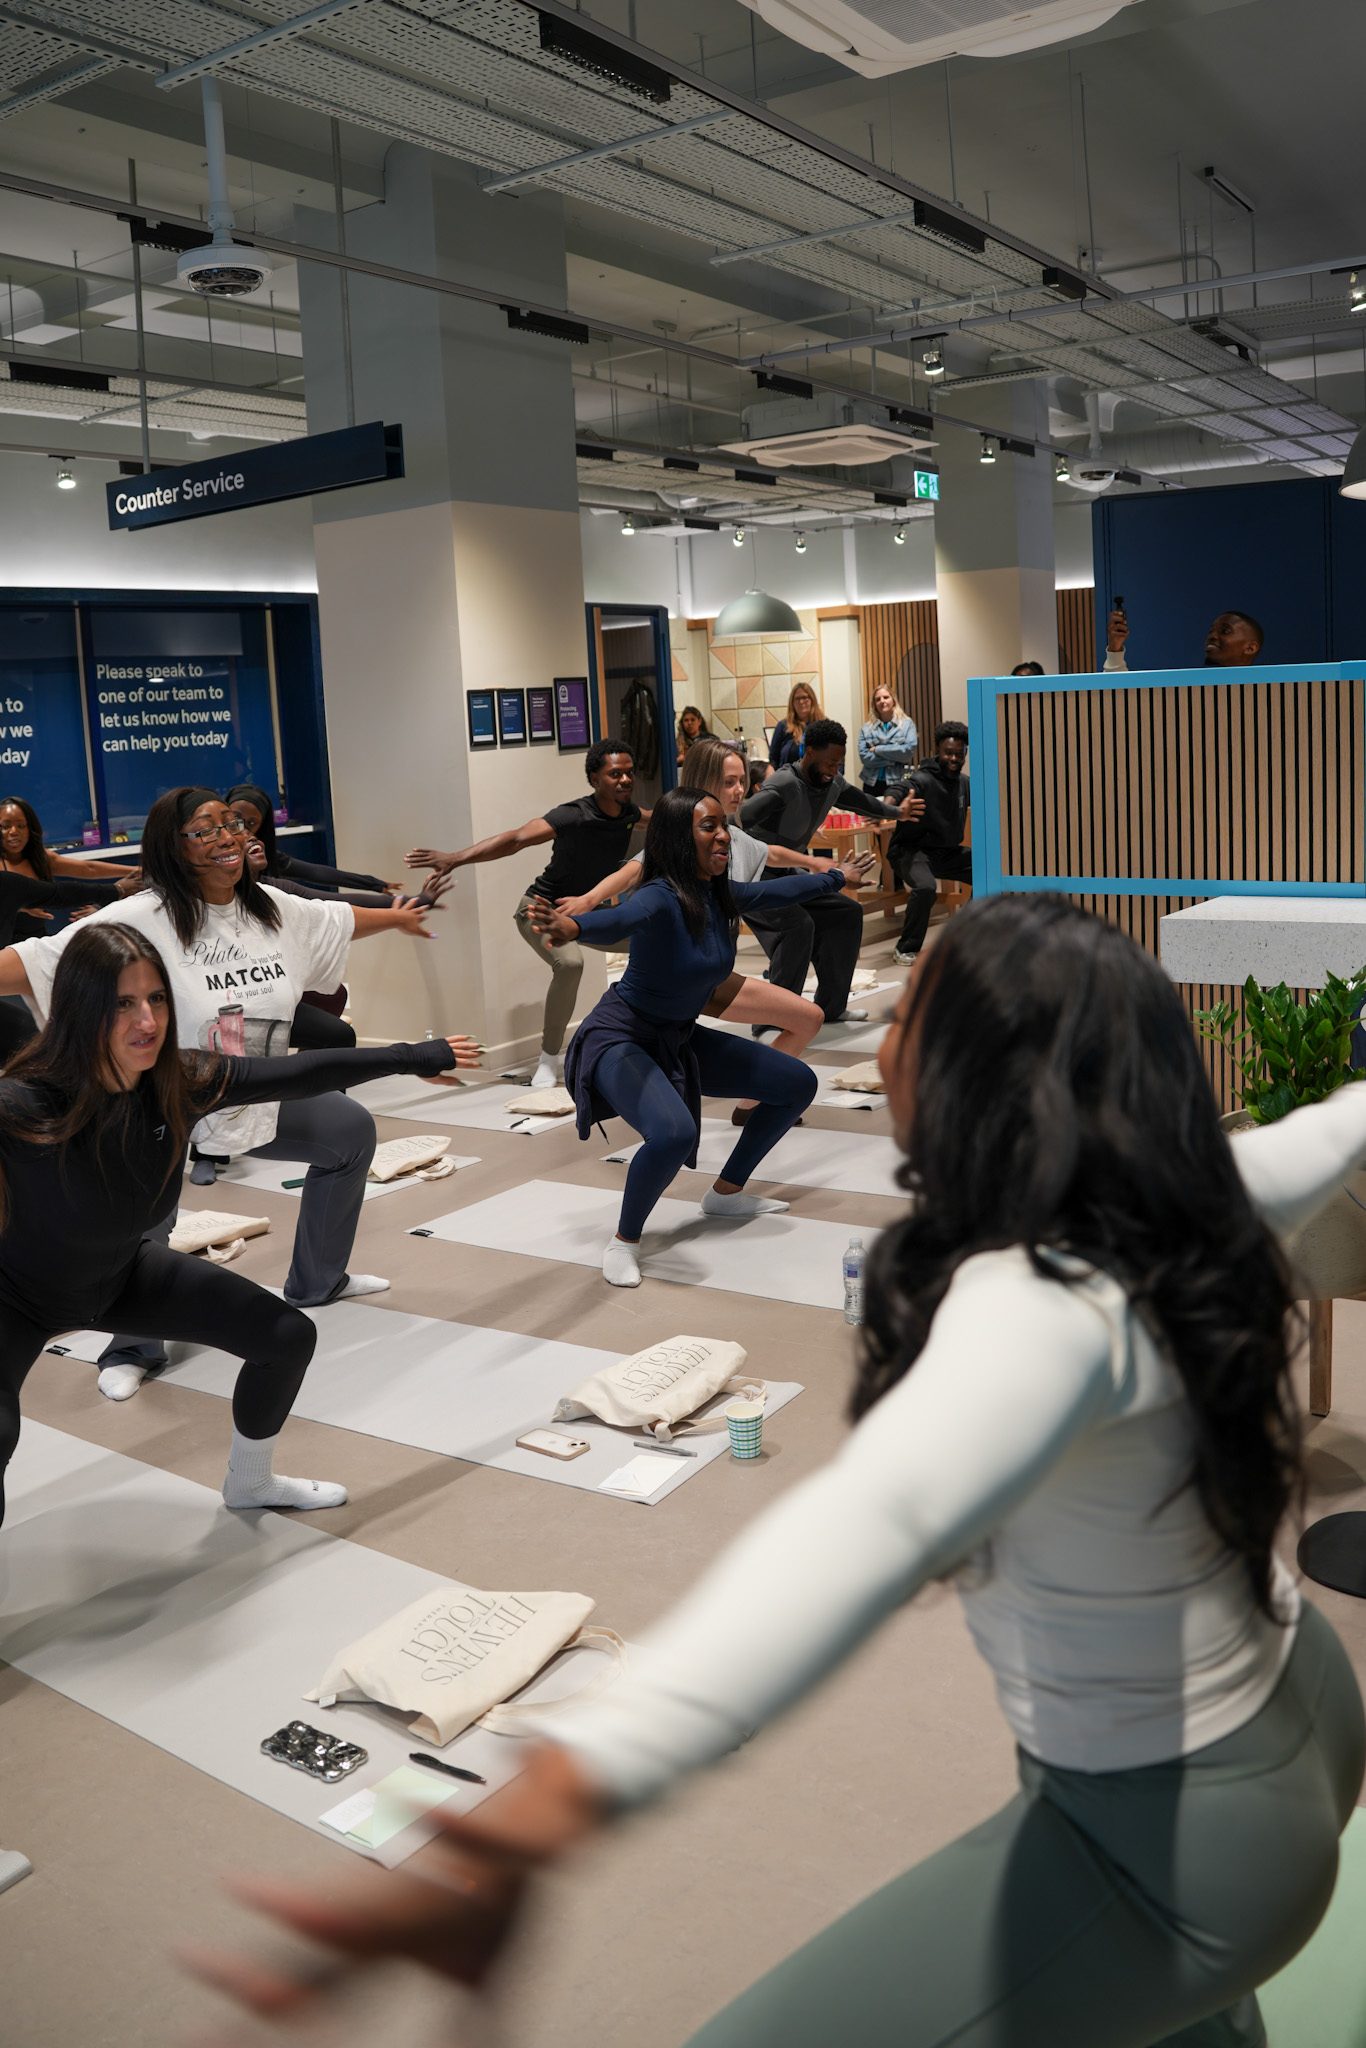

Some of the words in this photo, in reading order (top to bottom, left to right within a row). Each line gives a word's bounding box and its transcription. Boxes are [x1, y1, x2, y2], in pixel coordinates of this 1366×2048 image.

[115, 486, 179, 515] Counter
[182, 471, 245, 501] Service
[96, 664, 143, 680] Please
[145, 662, 187, 681] speak
[188, 663, 203, 677] to
[98, 691, 126, 704] one
[128, 687, 145, 702] of
[146, 689, 170, 702] our
[172, 687, 207, 701] team
[209, 685, 224, 699] to
[5, 697, 24, 713] to
[100, 712, 121, 728] let
[122, 714, 140, 727] us
[141, 710, 179, 726] know
[180, 708, 210, 724] how
[211, 709, 231, 721] we
[9, 725, 33, 738] we
[102, 740, 128, 753] can
[130, 734, 161, 753] help
[162, 736, 189, 752] you
[190, 730, 229, 749] today
[0, 747, 31, 768] day
[258, 955, 270, 966] your
[270, 950, 283, 962] body
[205, 962, 286, 991] MATCHA
[233, 989, 244, 999] for
[244, 988, 259, 1000] your
[260, 984, 274, 995] soul
[399, 1593, 497, 1663] TOUCH
